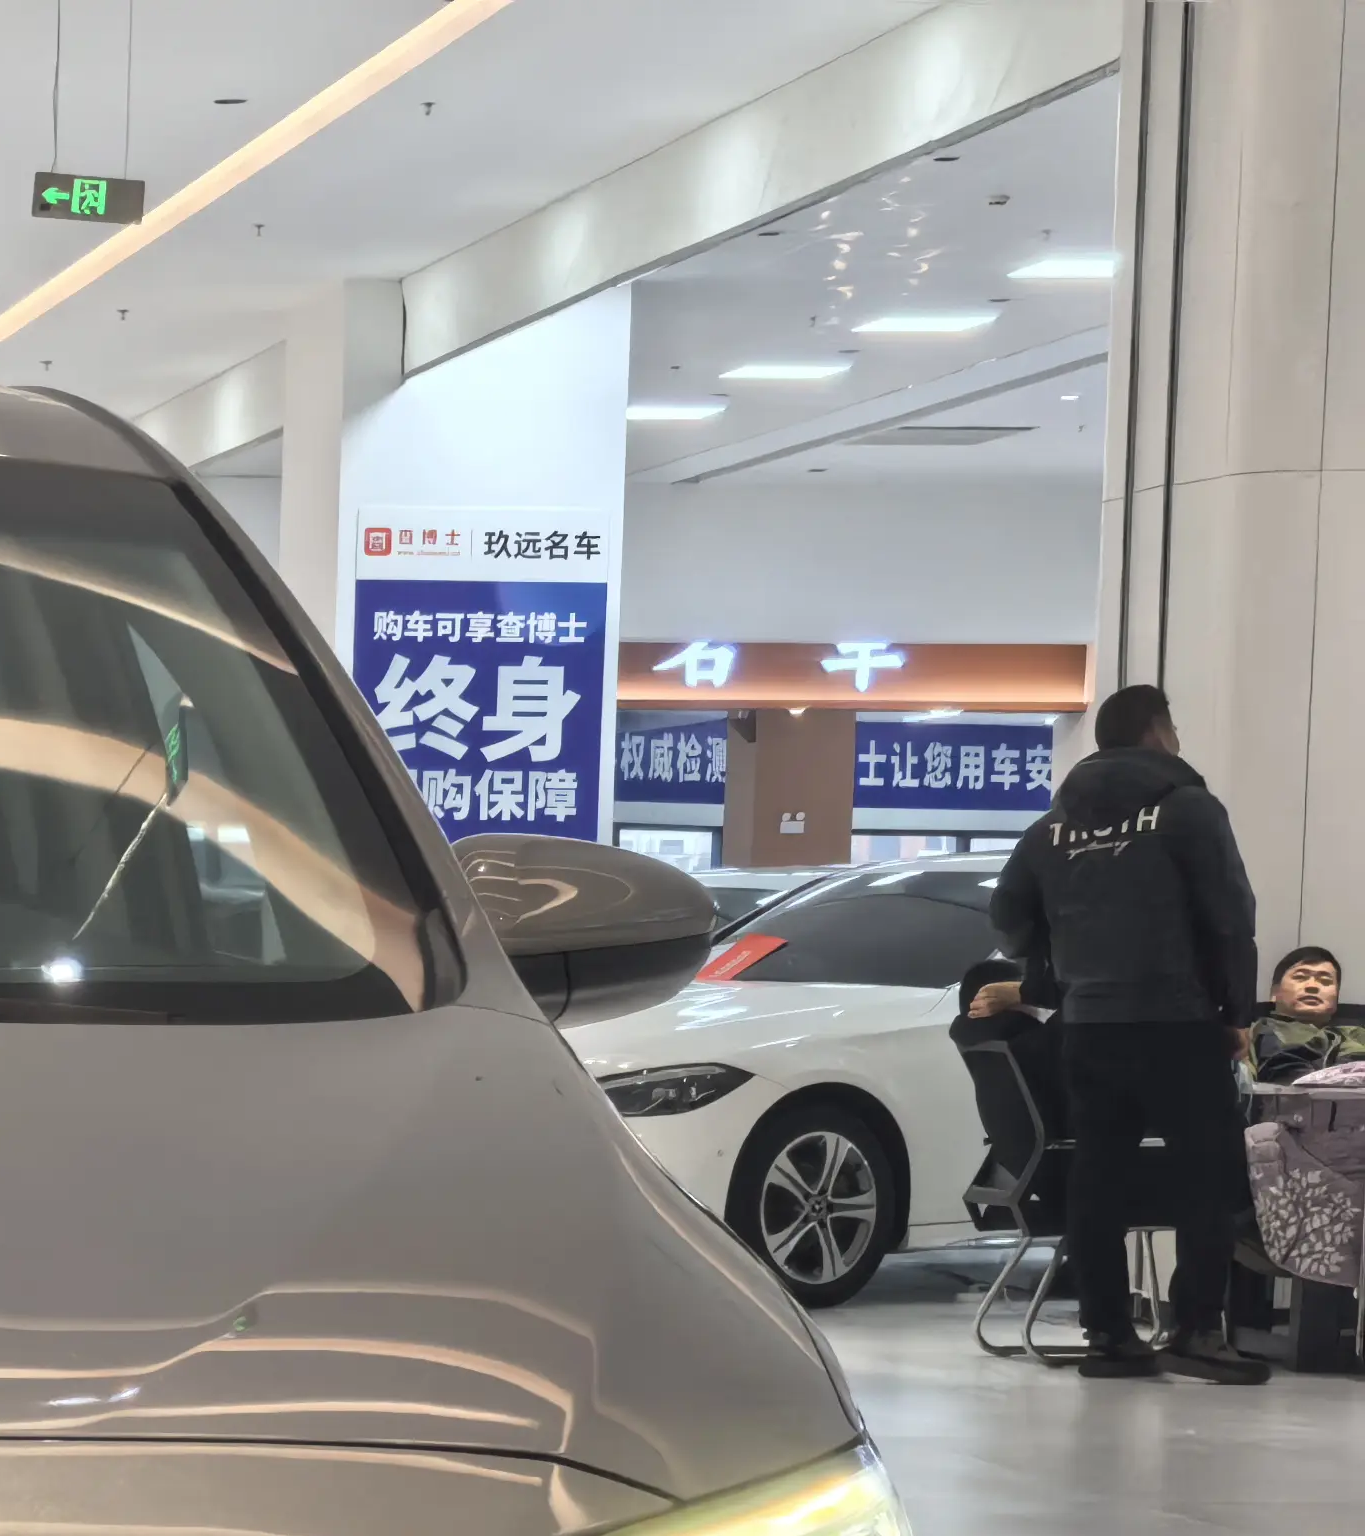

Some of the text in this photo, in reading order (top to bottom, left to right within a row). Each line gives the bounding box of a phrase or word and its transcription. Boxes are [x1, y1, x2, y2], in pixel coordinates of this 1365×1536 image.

[483, 531, 601, 560] 玖远名车
[373, 611, 588, 643] 购车可享查博士
[374, 653, 582, 763] 终身
[410, 768, 578, 822] 购保障
